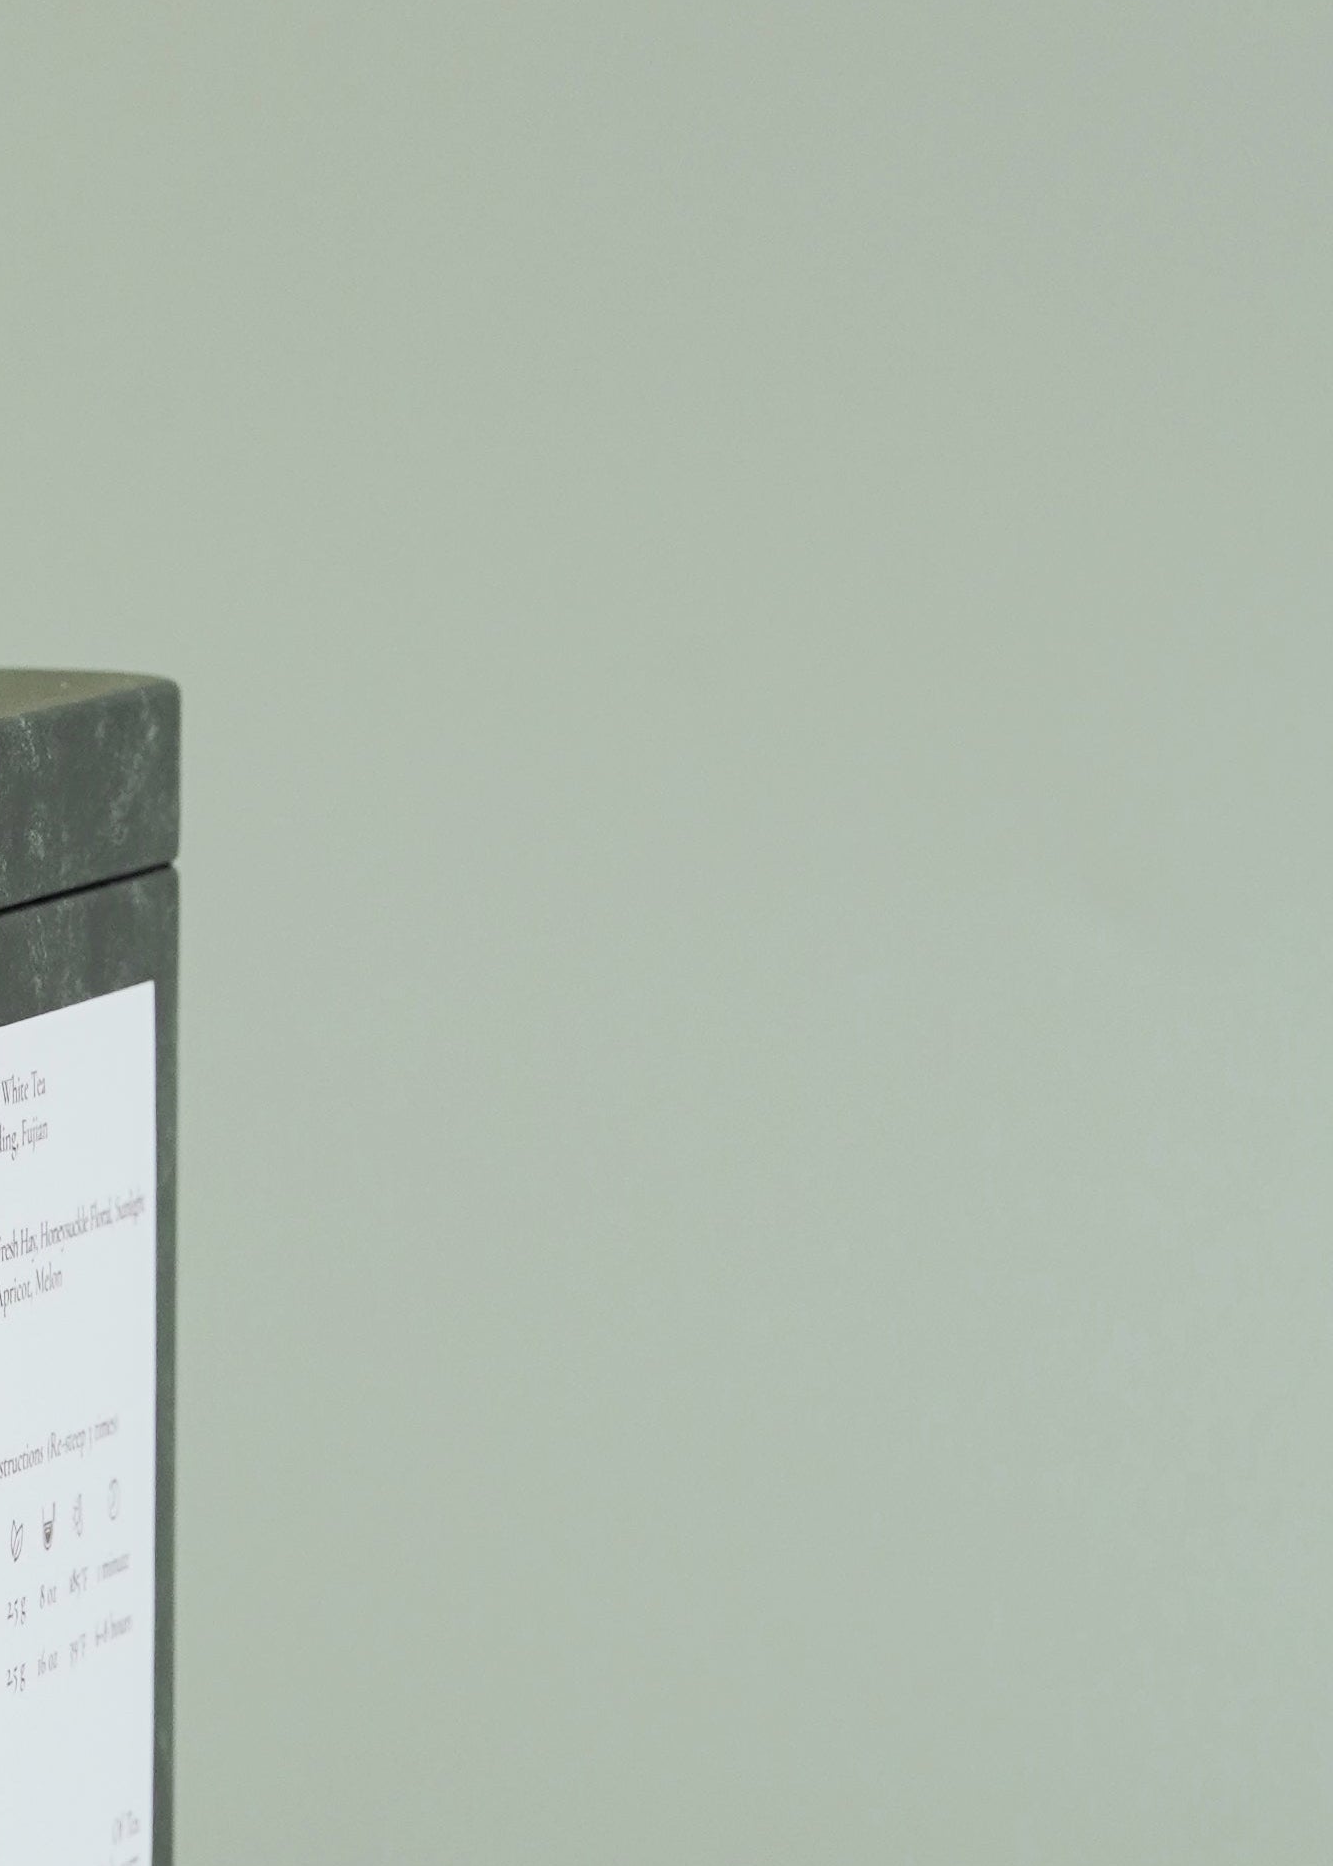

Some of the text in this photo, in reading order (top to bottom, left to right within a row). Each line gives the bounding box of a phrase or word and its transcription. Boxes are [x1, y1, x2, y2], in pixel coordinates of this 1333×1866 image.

[1, 1076, 30, 1106] White
[31, 1070, 46, 1098] Tea
[21, 1115, 48, 1151] Fujian
[35, 1261, 63, 1297] Melon
